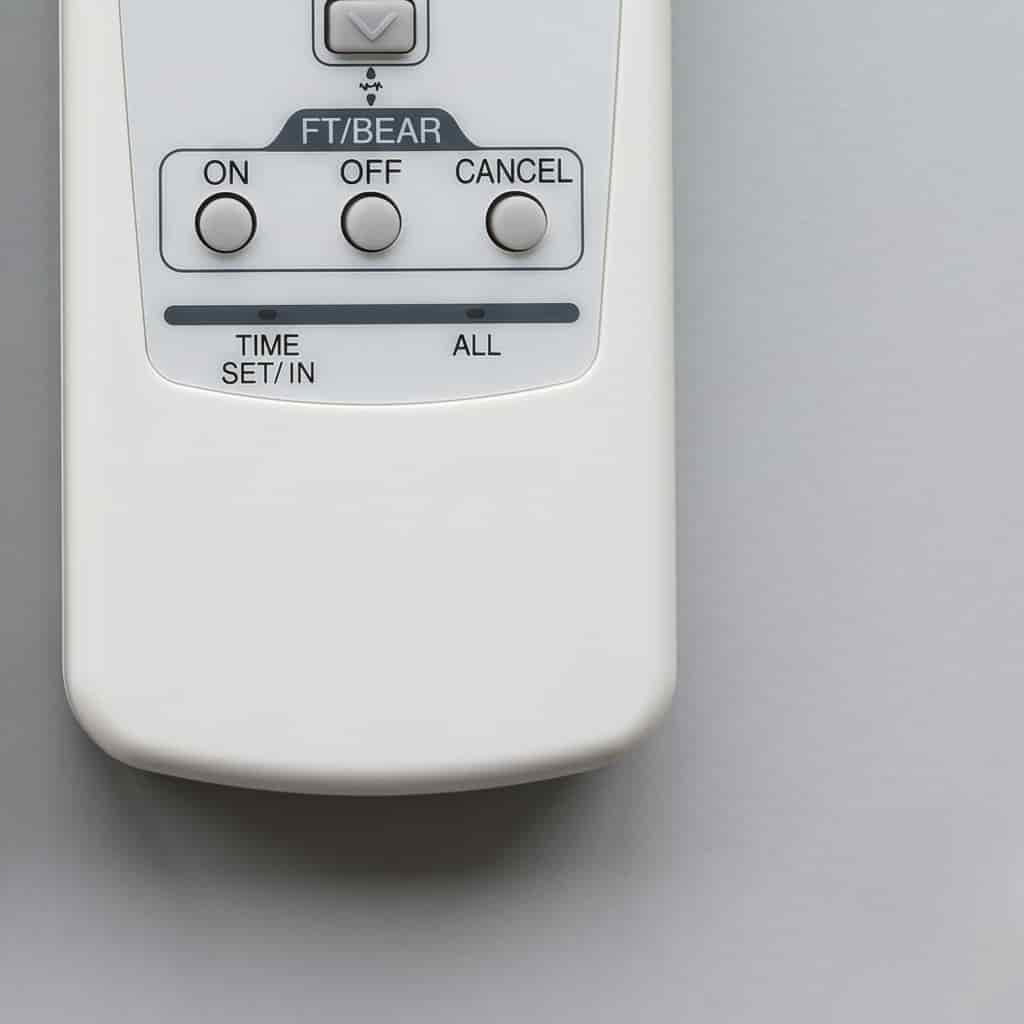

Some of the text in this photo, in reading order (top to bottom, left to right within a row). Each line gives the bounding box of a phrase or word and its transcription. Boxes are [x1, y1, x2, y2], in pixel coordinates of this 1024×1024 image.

[301, 116, 441, 145] FT/BEAR
[203, 159, 249, 186] ON
[340, 158, 402, 186] OFF
[455, 157, 573, 185] CANCEL
[235, 334, 300, 356] TIME
[453, 334, 501, 356] ALL
